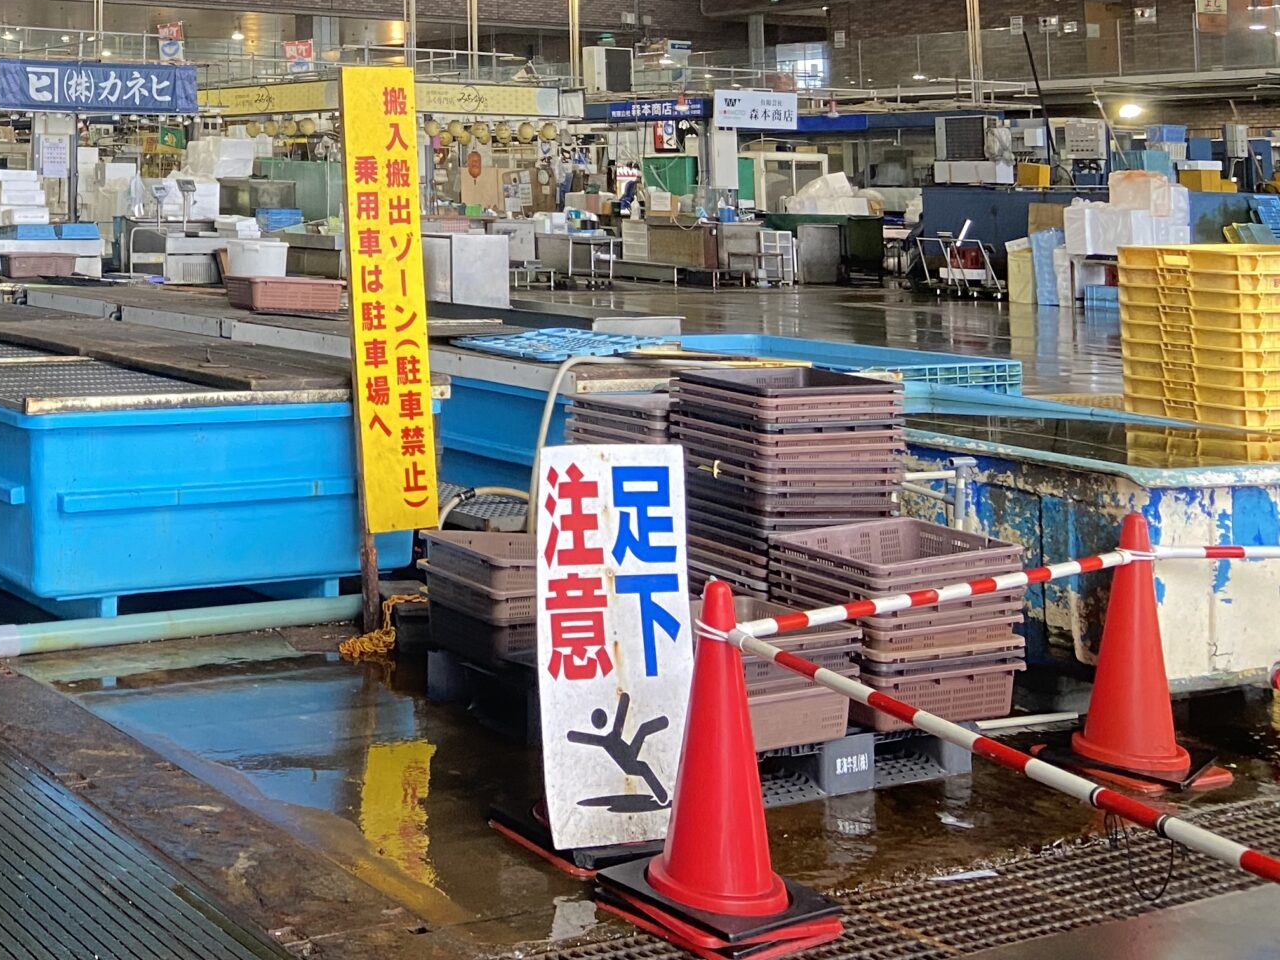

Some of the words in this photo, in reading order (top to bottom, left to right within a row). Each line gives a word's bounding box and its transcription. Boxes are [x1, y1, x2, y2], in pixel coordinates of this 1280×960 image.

[631, 102, 672, 117] 森本商店
[749, 108, 793, 122] 森本商店
[354, 155, 393, 438] 乗用車は駐車場へ
[543, 462, 614, 682] 注意
[611, 465, 682, 678] 足下
